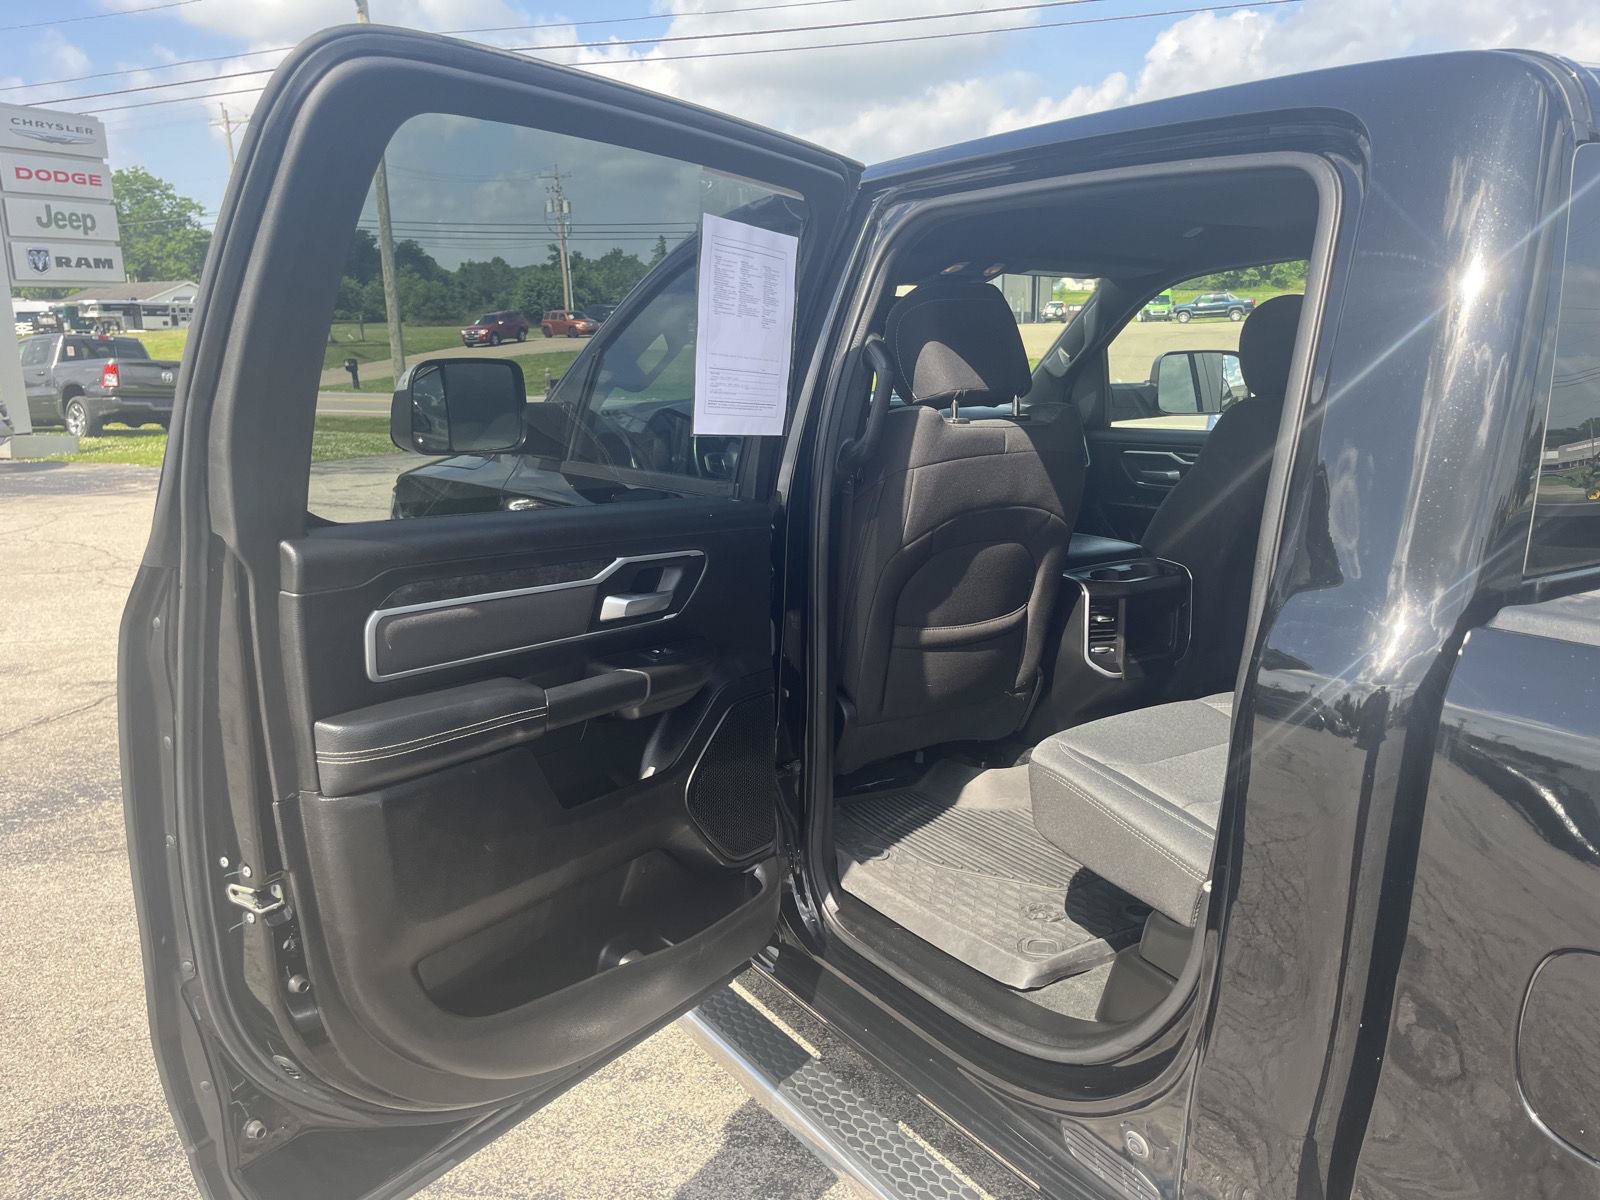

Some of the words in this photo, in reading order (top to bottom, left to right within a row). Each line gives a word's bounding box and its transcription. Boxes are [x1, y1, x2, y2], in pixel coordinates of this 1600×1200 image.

[10, 117, 95, 135] CHRYSLER
[15, 167, 103, 187] DODGE
[36, 204, 96, 235] Jeep
[55, 256, 114, 269] RAM
